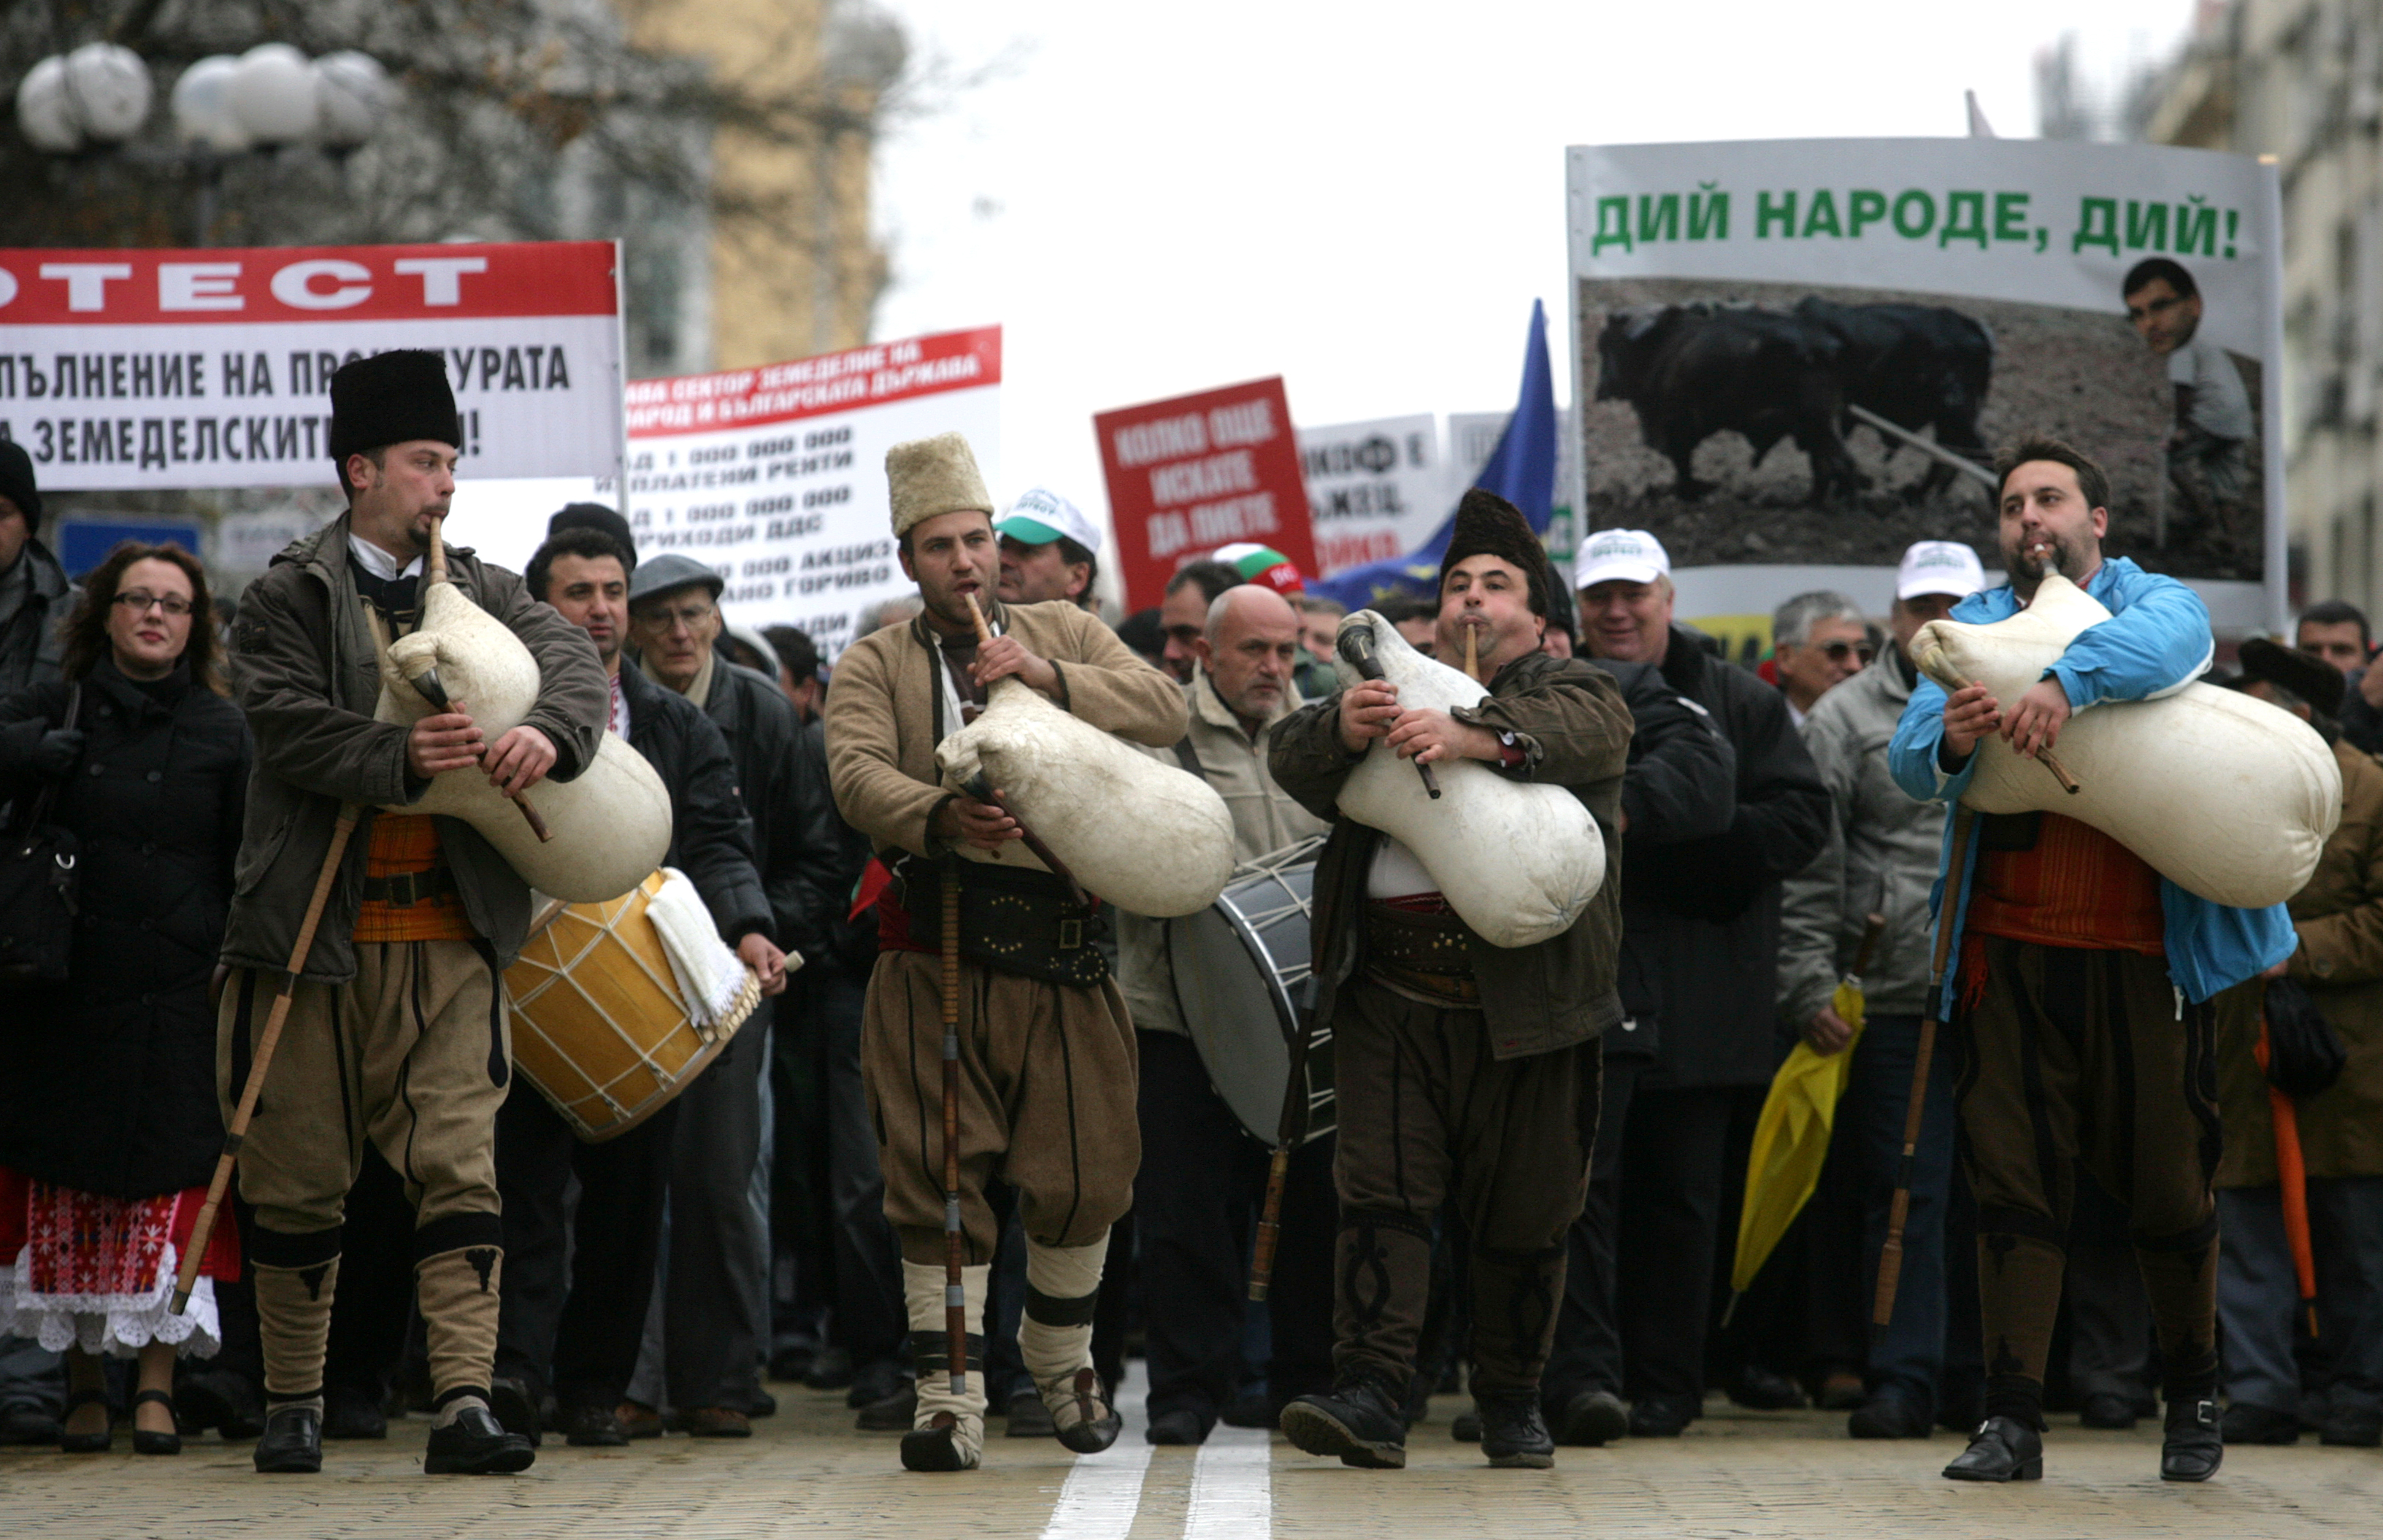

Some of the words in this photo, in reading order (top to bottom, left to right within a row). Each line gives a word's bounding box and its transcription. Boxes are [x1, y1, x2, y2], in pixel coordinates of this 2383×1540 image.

[1592, 182, 1730, 255] ДИЙ
[1756, 188, 2049, 253] НАРОДЕ,
[2070, 194, 2241, 261] ДИЙ!
[0, 257, 488, 313] ТЕСТ
[222, 350, 273, 397] НА
[672, 371, 753, 402] СЕКТОР
[759, 348, 886, 390] ЗЕМЕДЕЛИЕ
[889, 340, 921, 365] НА
[718, 374, 868, 422] БЪЛГАРСКАТА
[870, 353, 981, 397] ДЪРЖАВА
[690, 446, 737, 465] 000
[748, 437, 794, 459] 000
[805, 426, 852, 450] 000
[767, 450, 853, 482] РЕНТИ
[687, 504, 734, 523] 000
[745, 495, 793, 517] 000
[803, 485, 850, 509] 000
[766, 513, 823, 541] ДДС
[801, 539, 891, 571] АКЦИЗ
[783, 565, 891, 598] ГОРИВО
